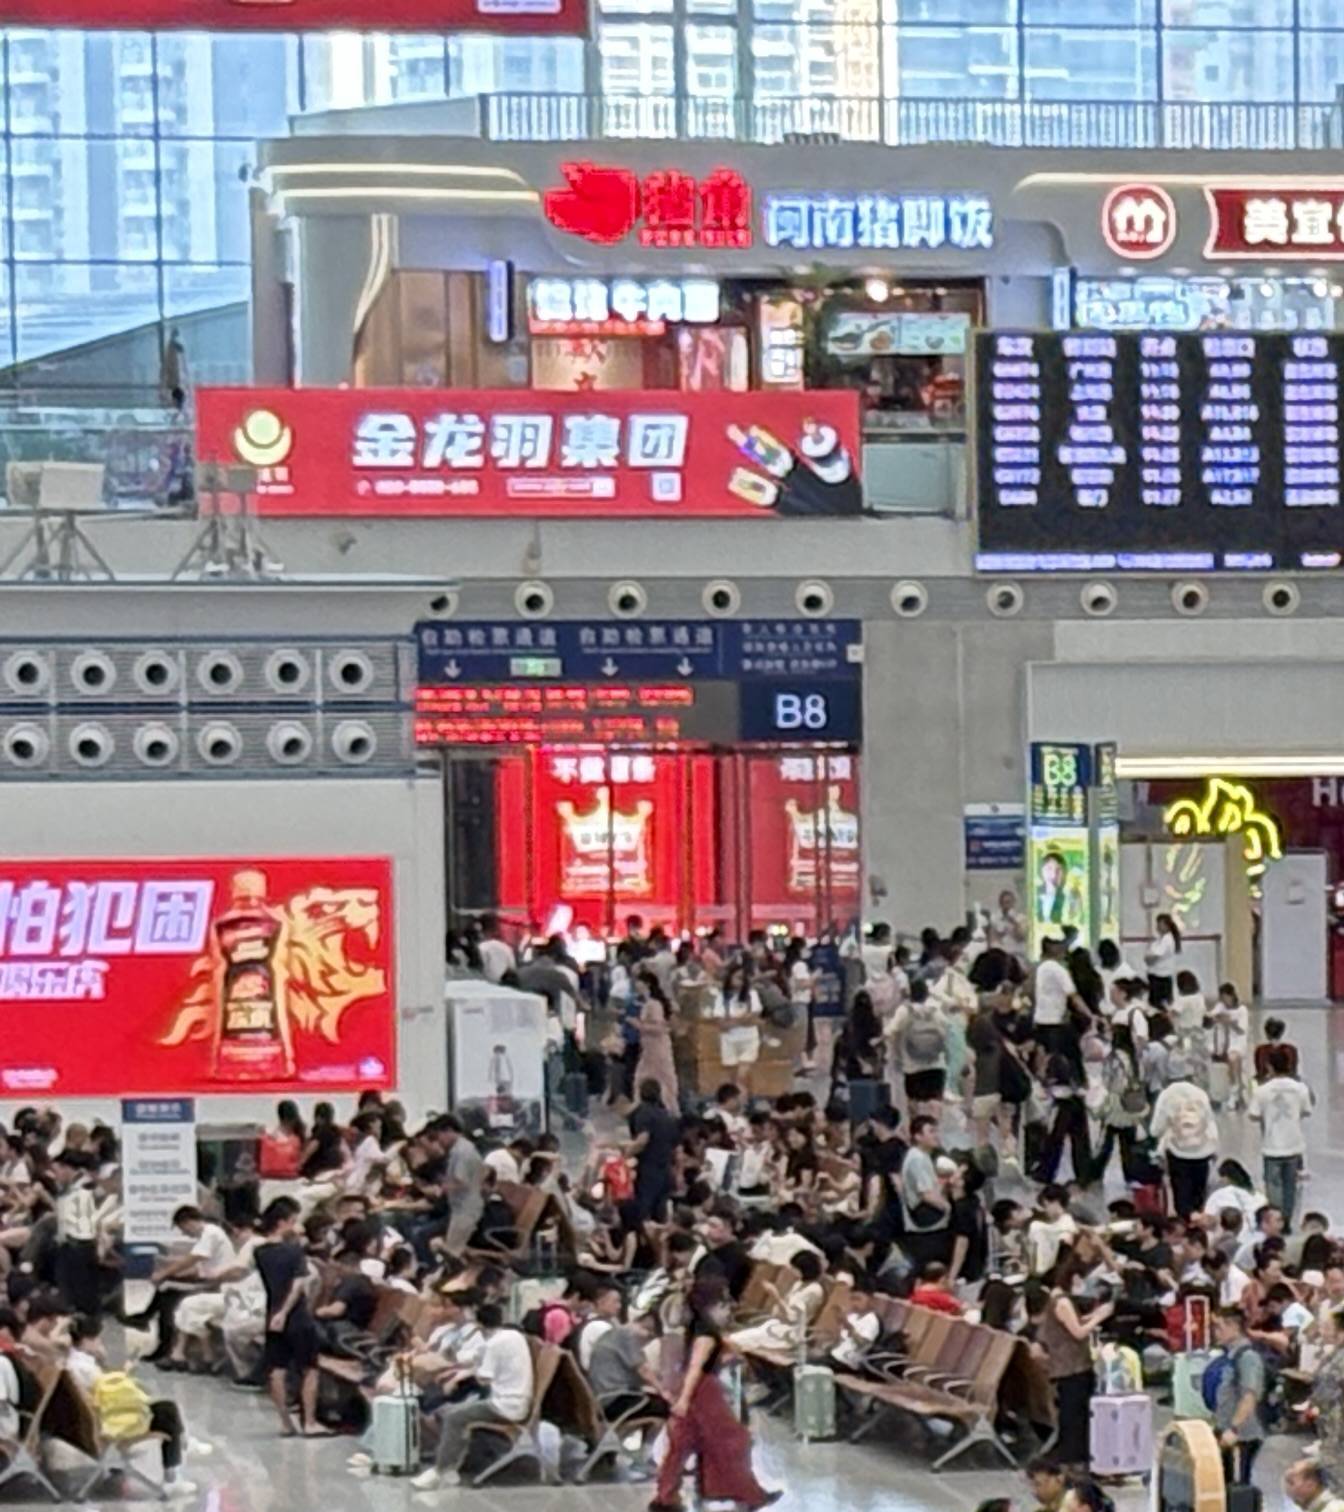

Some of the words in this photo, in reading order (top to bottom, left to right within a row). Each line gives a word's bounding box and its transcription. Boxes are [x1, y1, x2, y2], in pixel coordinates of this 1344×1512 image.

[352, 413, 689, 468] 金龙羽集团
[776, 693, 828, 730] B8
[1044, 753, 1077, 786] B8
[0, 879, 215, 956] 怕犯困
